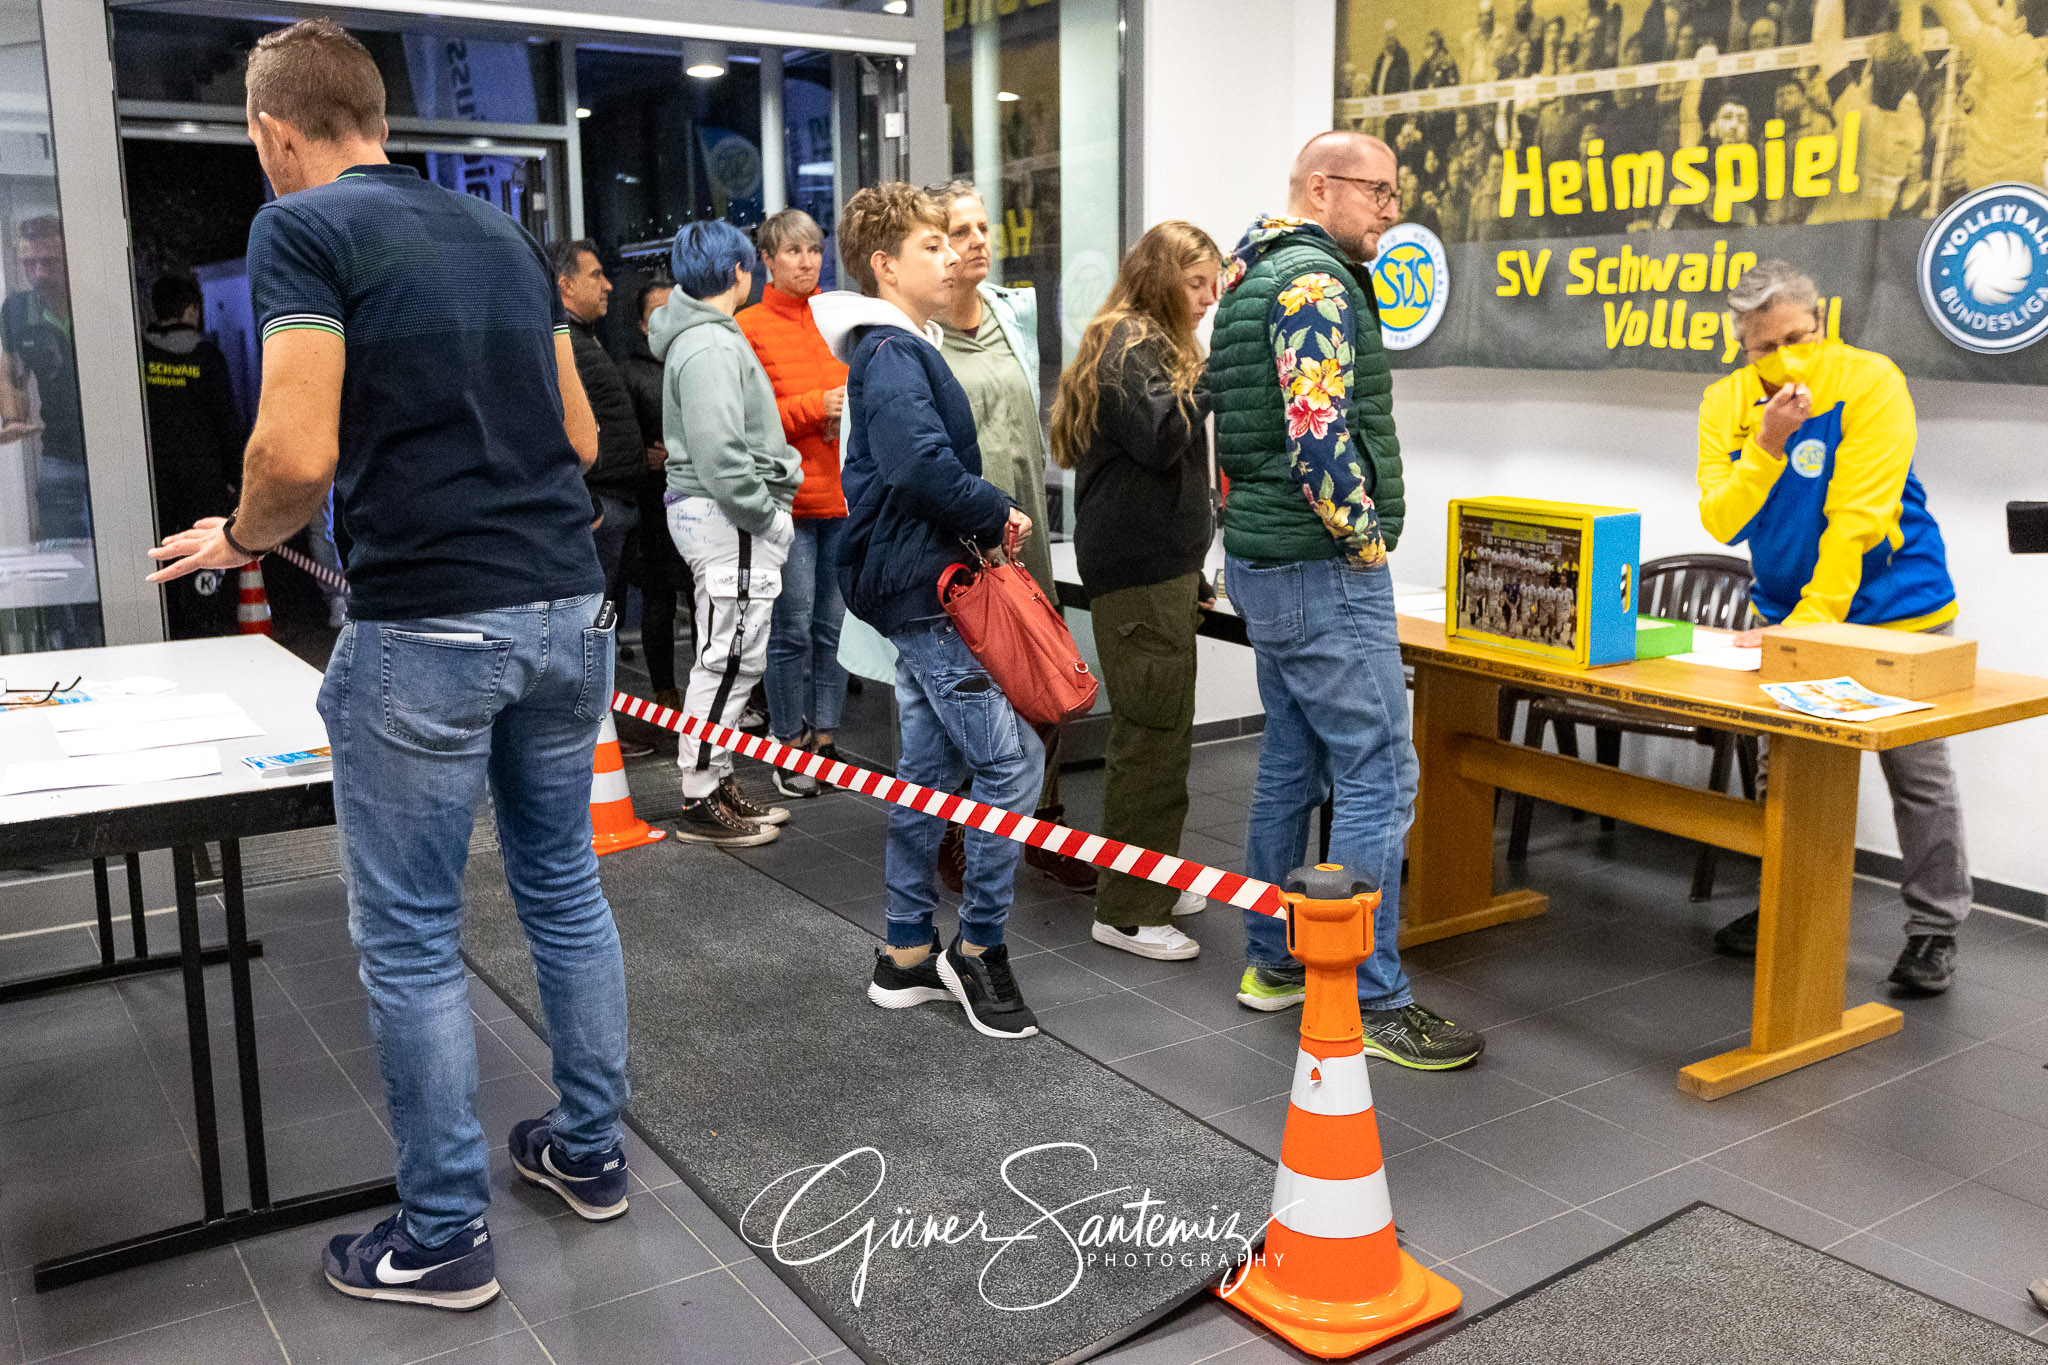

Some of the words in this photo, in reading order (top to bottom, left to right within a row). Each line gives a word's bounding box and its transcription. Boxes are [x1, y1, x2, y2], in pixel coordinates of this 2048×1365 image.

[1498, 109, 1861, 224] Heimspiel
[1496, 248, 1552, 297] SV
[1939, 285, 2048, 332] BUNDESLIGA
[603, 1158, 620, 1172] NIKE
[473, 1231, 489, 1249] NIKE
